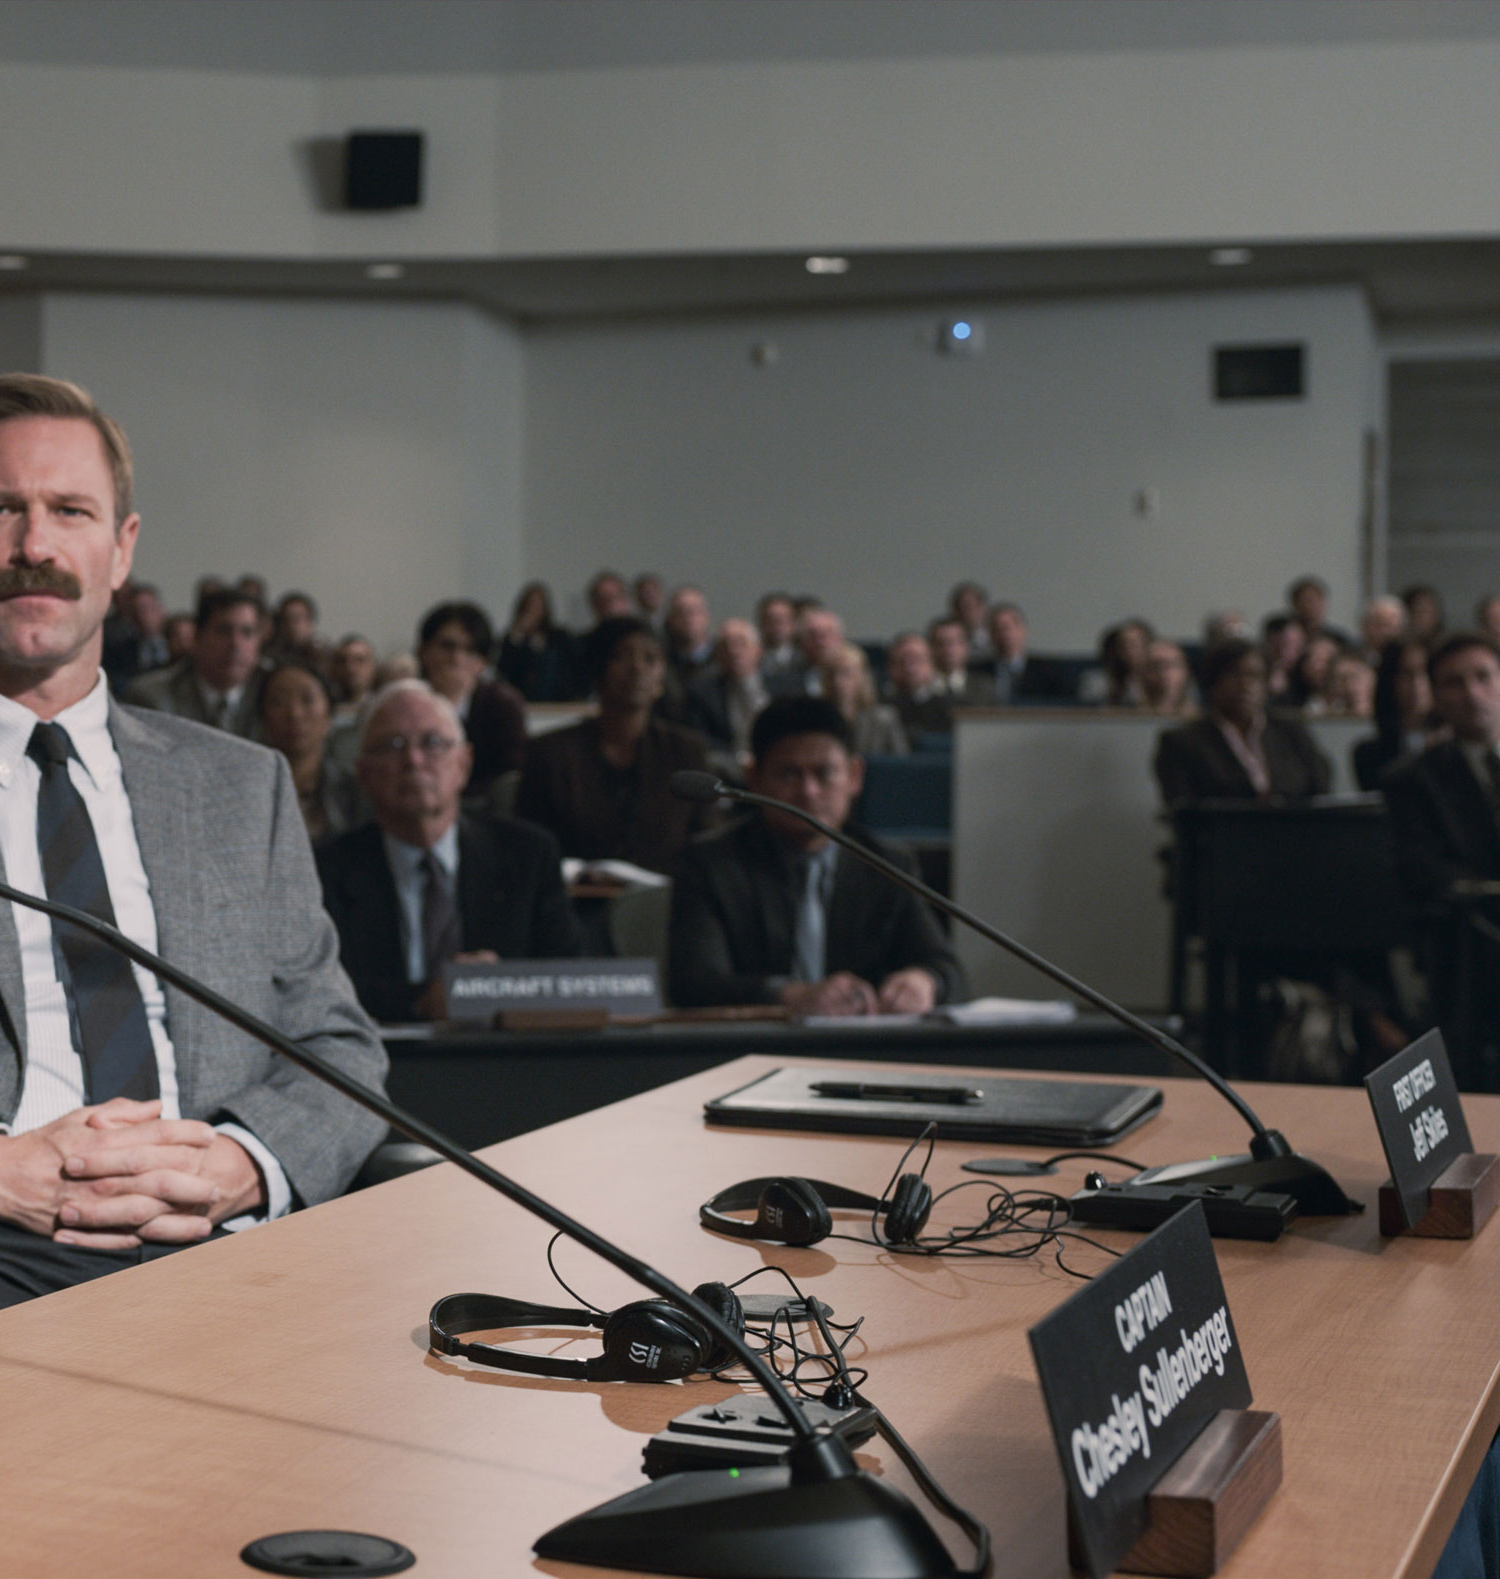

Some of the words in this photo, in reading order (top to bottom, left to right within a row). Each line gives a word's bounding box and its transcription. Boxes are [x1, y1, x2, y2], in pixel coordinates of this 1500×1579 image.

[452, 975, 554, 998] AIRCRAFT
[557, 973, 654, 997] SYSTEMS
[1114, 1270, 1173, 1353] CAPTAIN
[1071, 1393, 1151, 1499] Chesley
[1139, 1305, 1233, 1428] Sullenberger
